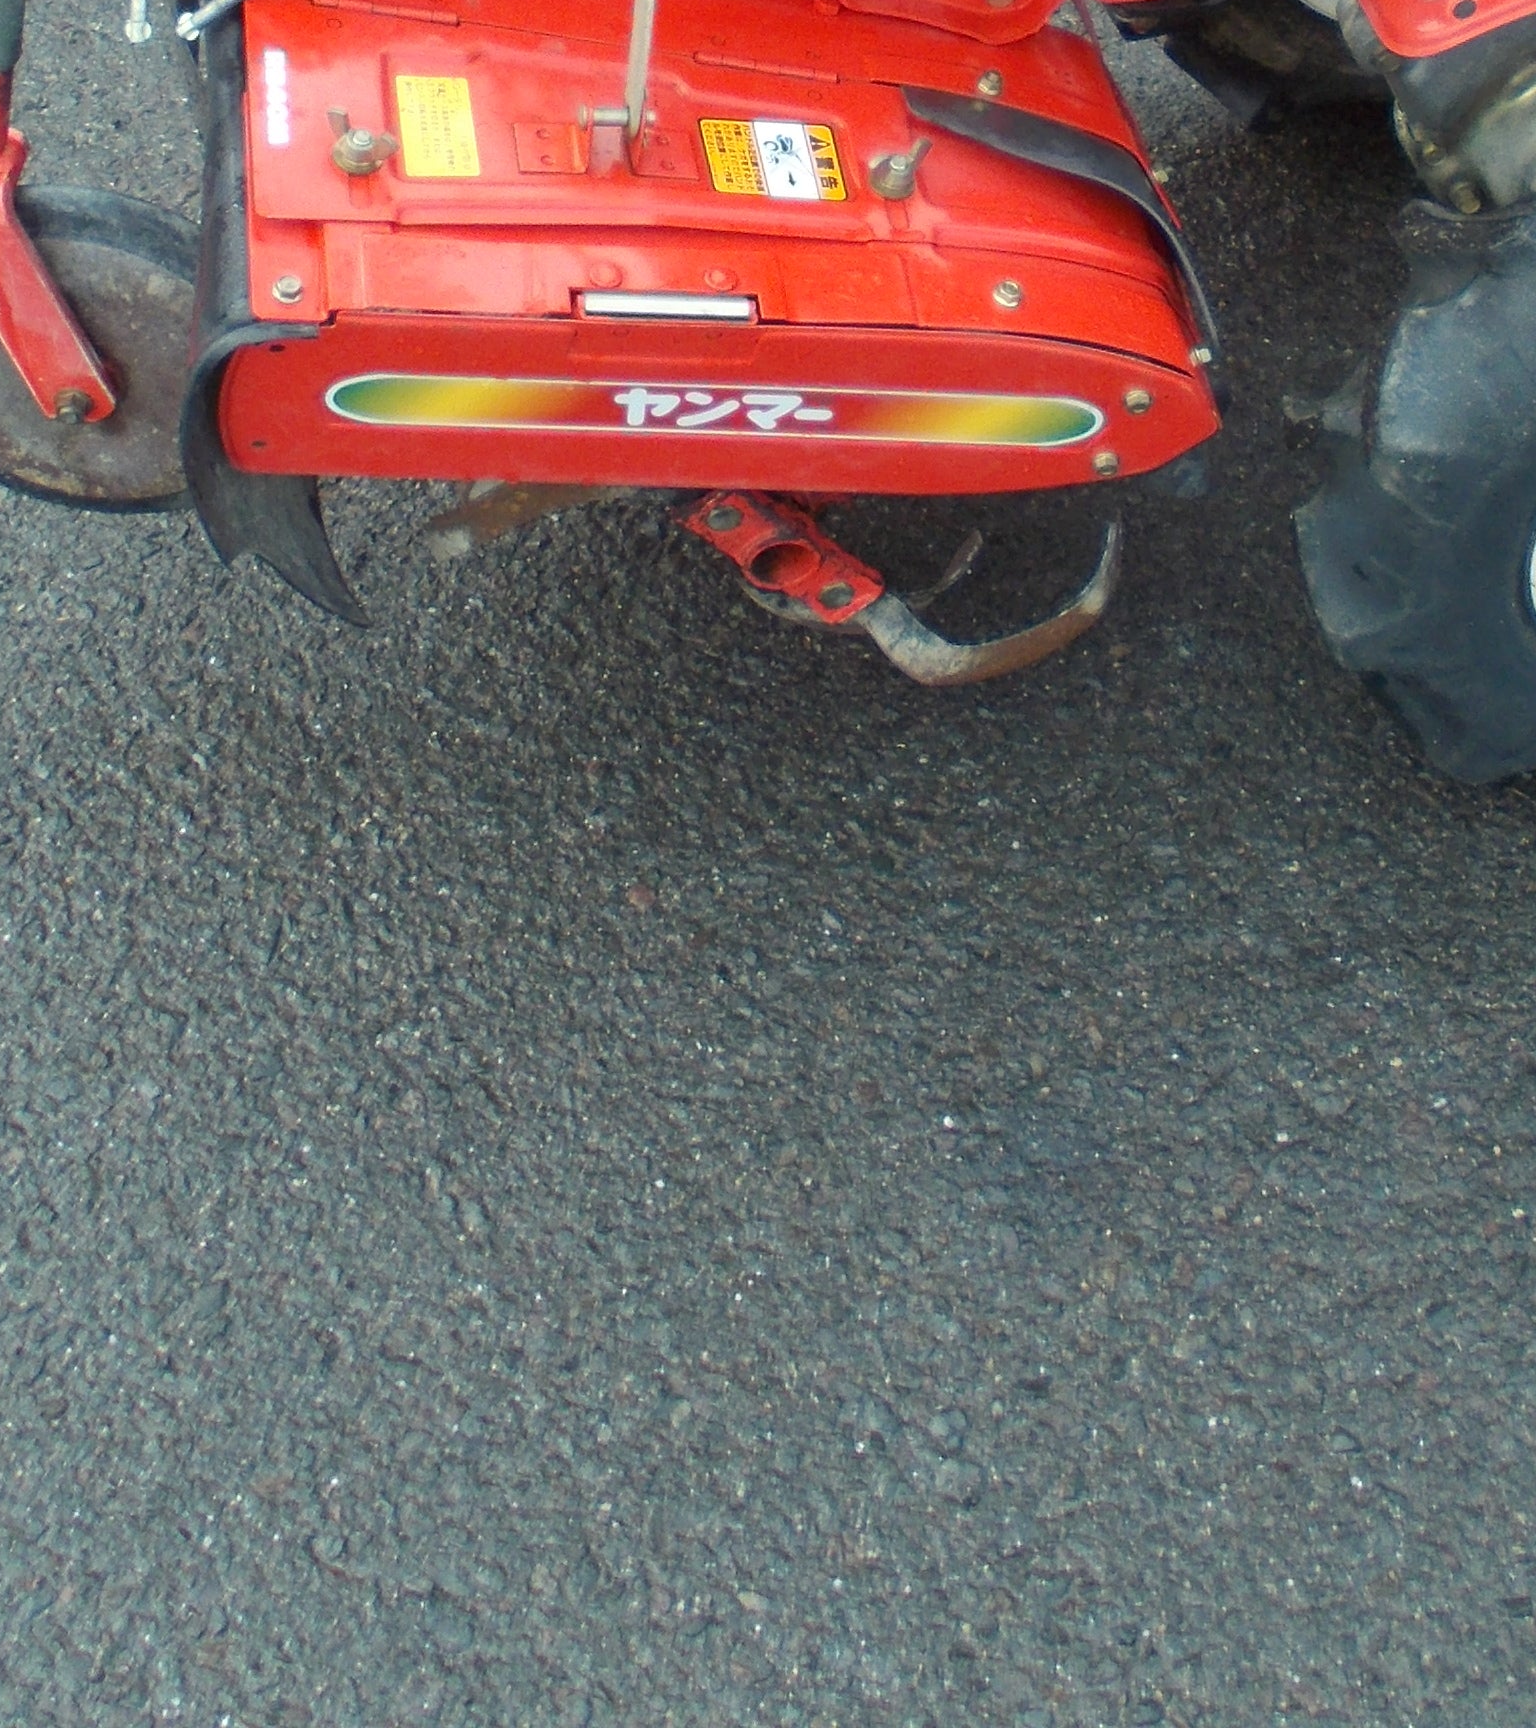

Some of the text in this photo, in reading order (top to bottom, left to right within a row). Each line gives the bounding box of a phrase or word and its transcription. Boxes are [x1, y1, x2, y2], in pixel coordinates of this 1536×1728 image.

[816, 157, 839, 190] 警告
[614, 388, 833, 429] ヤンマー
